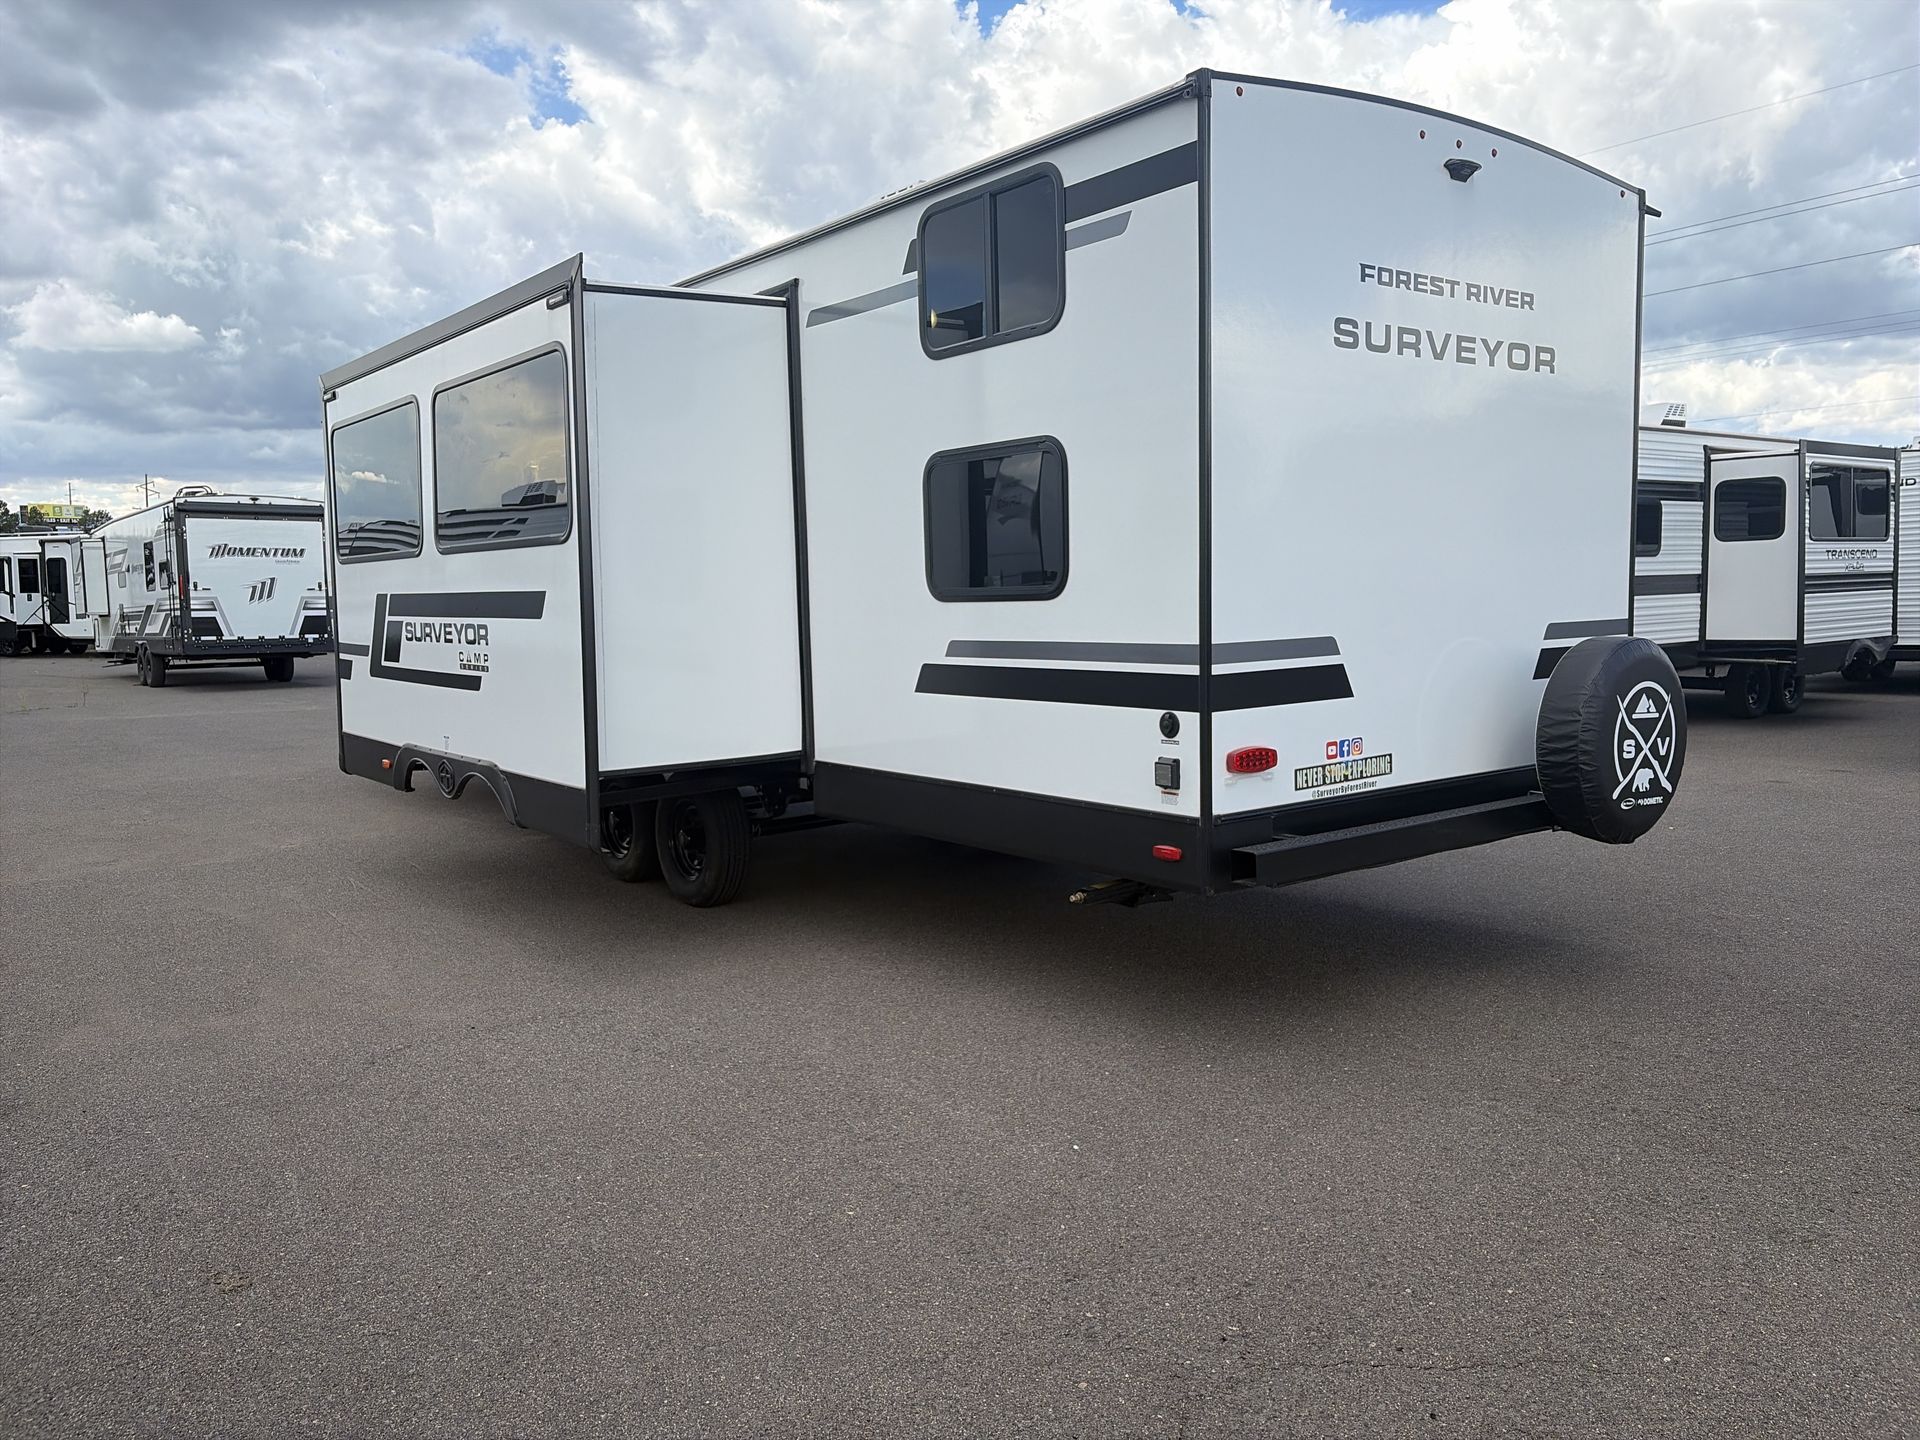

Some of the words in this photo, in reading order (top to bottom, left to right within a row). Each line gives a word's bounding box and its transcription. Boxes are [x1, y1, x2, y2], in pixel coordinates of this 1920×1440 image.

[1358, 263, 1461, 299] FOREST
[1465, 282, 1535, 311] RIVER
[1333, 316, 1556, 374] SURVEYOR
[207, 543, 306, 559] MOMENTUM
[1825, 549, 1878, 560] TRANSCEND
[404, 621, 489, 646] SURVEYOR
[458, 650, 489, 664] CAMP
[1622, 739, 1636, 759] S
[1656, 737, 1670, 756] V
[1296, 766, 1324, 789] NEVER
[1325, 762, 1346, 785] STOP
[1347, 755, 1391, 780] EXPLORING
